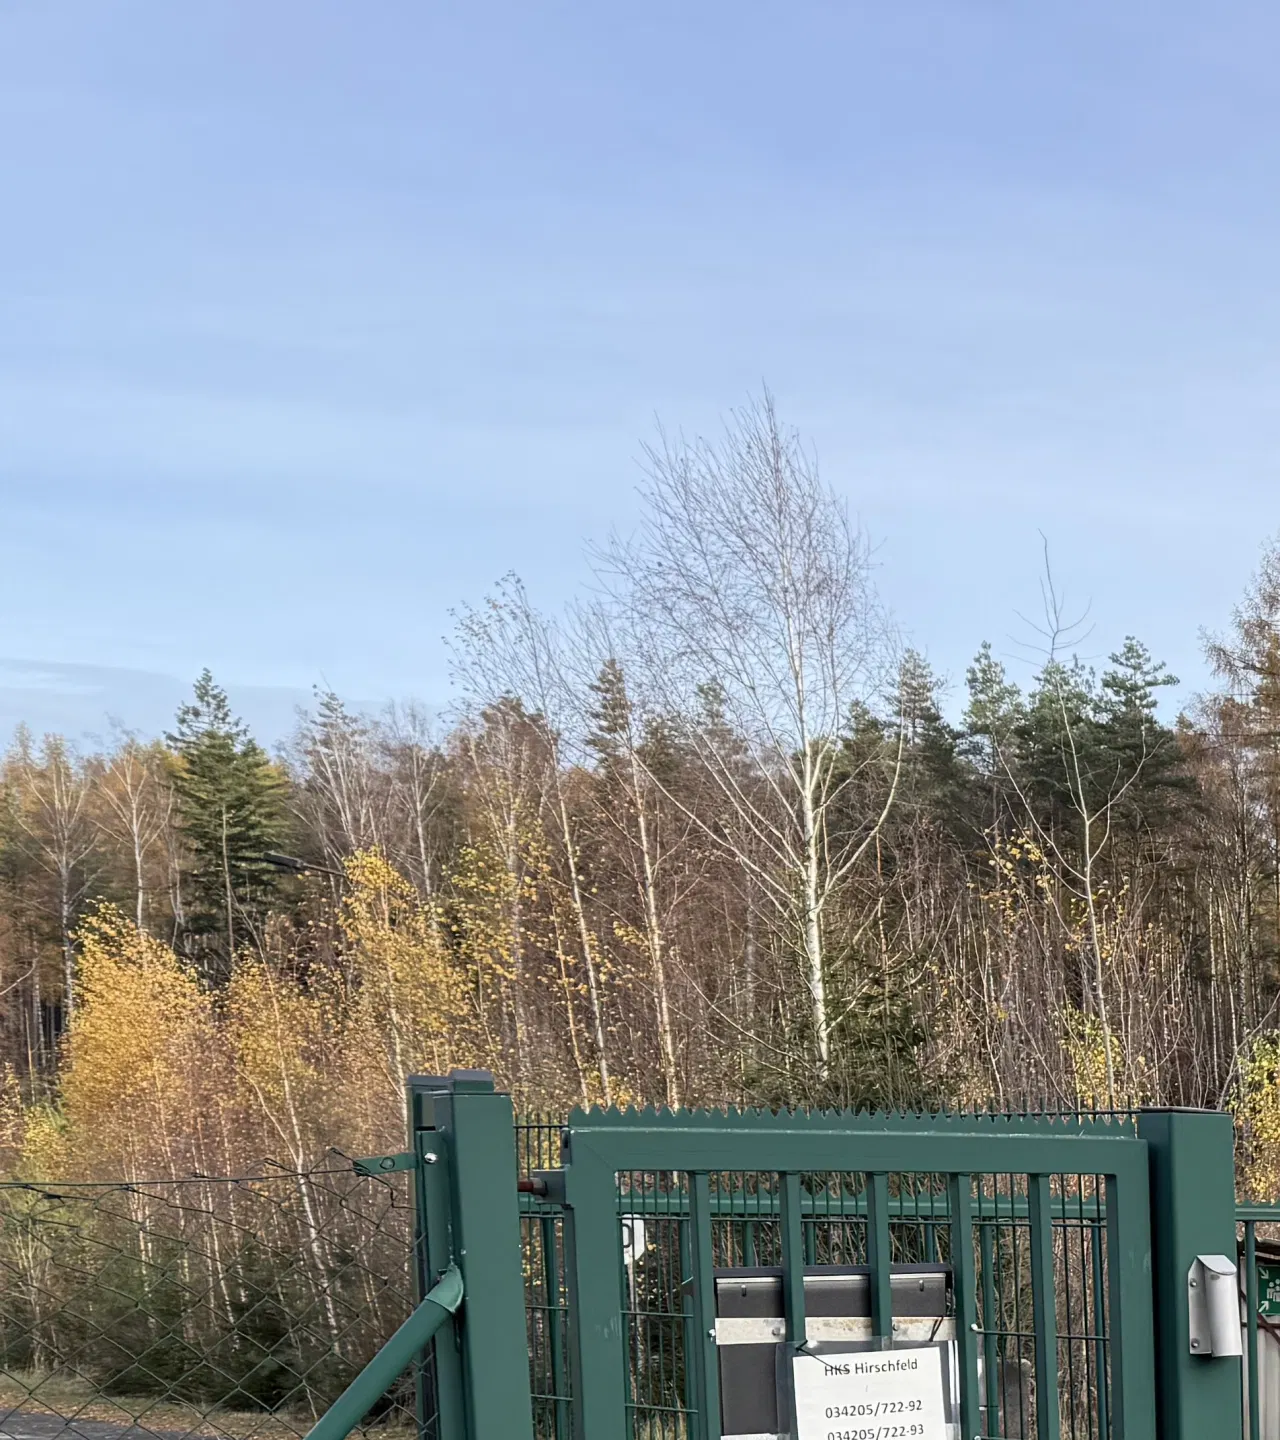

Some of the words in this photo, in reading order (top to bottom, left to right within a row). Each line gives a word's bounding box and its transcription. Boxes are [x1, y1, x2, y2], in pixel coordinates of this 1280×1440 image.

[824, 1364, 851, 1376] HKS
[855, 1358, 918, 1374] Hirschfeld
[825, 1399, 923, 1419] 034205/722-92
